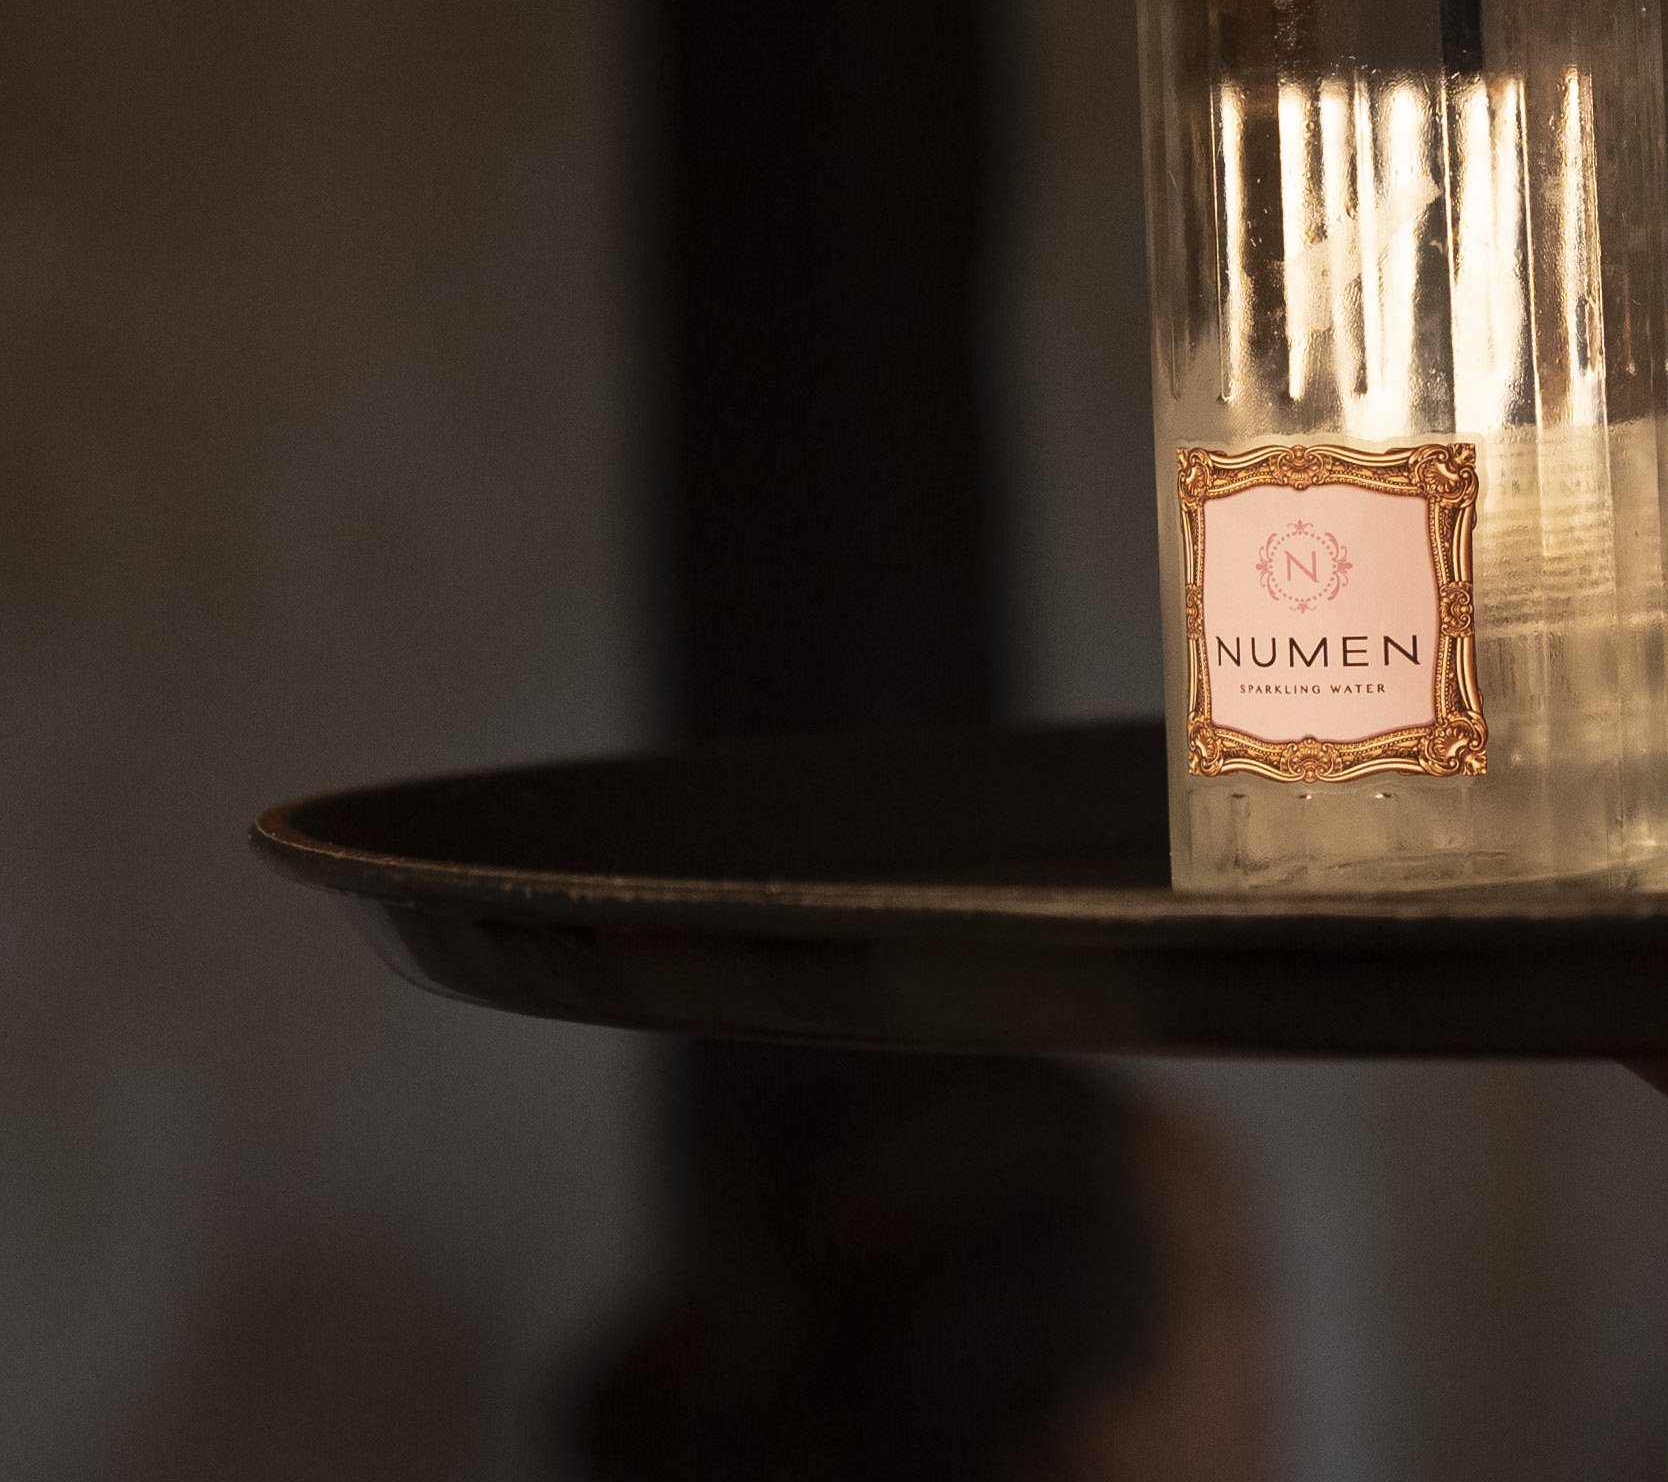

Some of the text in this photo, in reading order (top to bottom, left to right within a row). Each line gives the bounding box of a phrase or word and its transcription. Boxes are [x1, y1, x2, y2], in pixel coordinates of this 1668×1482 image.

[1284, 550, 1320, 583] N
[1215, 634, 1421, 668] NUMEN
[1240, 683, 1386, 695] SPARKLING WATER
